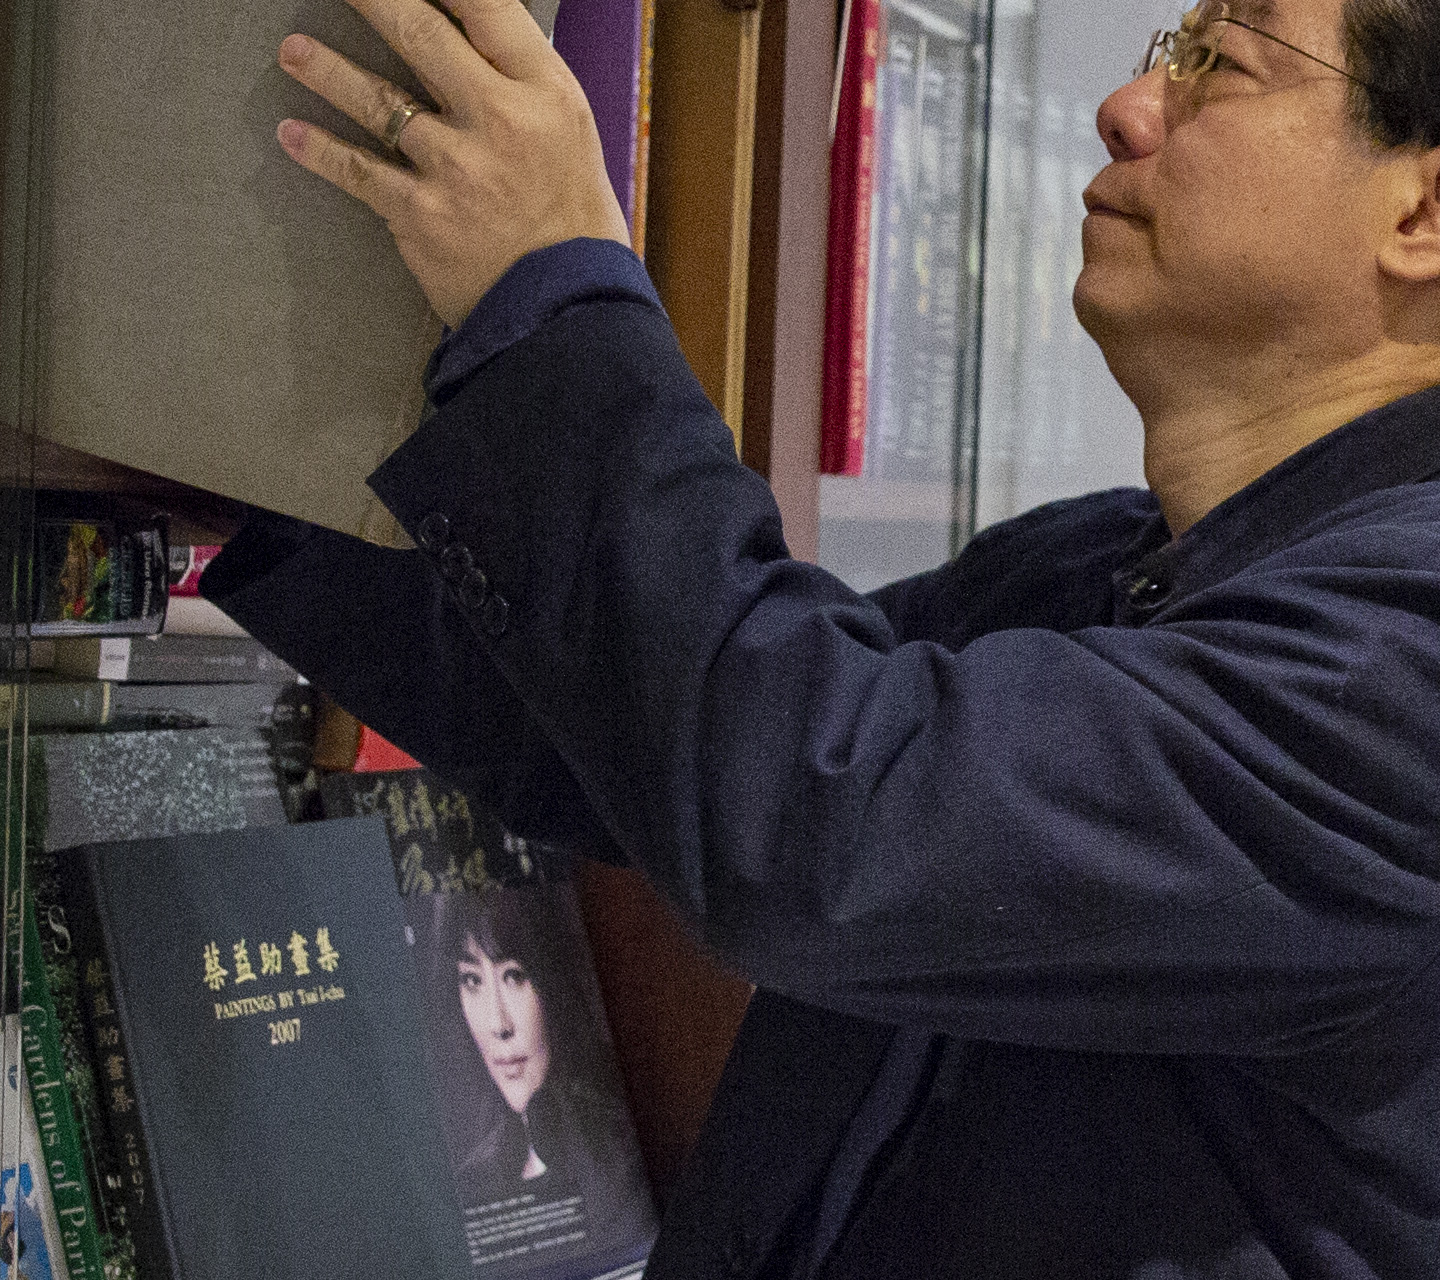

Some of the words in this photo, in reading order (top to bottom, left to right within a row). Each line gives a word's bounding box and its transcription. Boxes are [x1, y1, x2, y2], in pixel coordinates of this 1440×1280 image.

[214, 994, 277, 1020] PAINTINGS
[268, 1018, 302, 1046] 2007
[22, 1003, 62, 1149] Gardens
[51, 1158, 79, 1194] of
